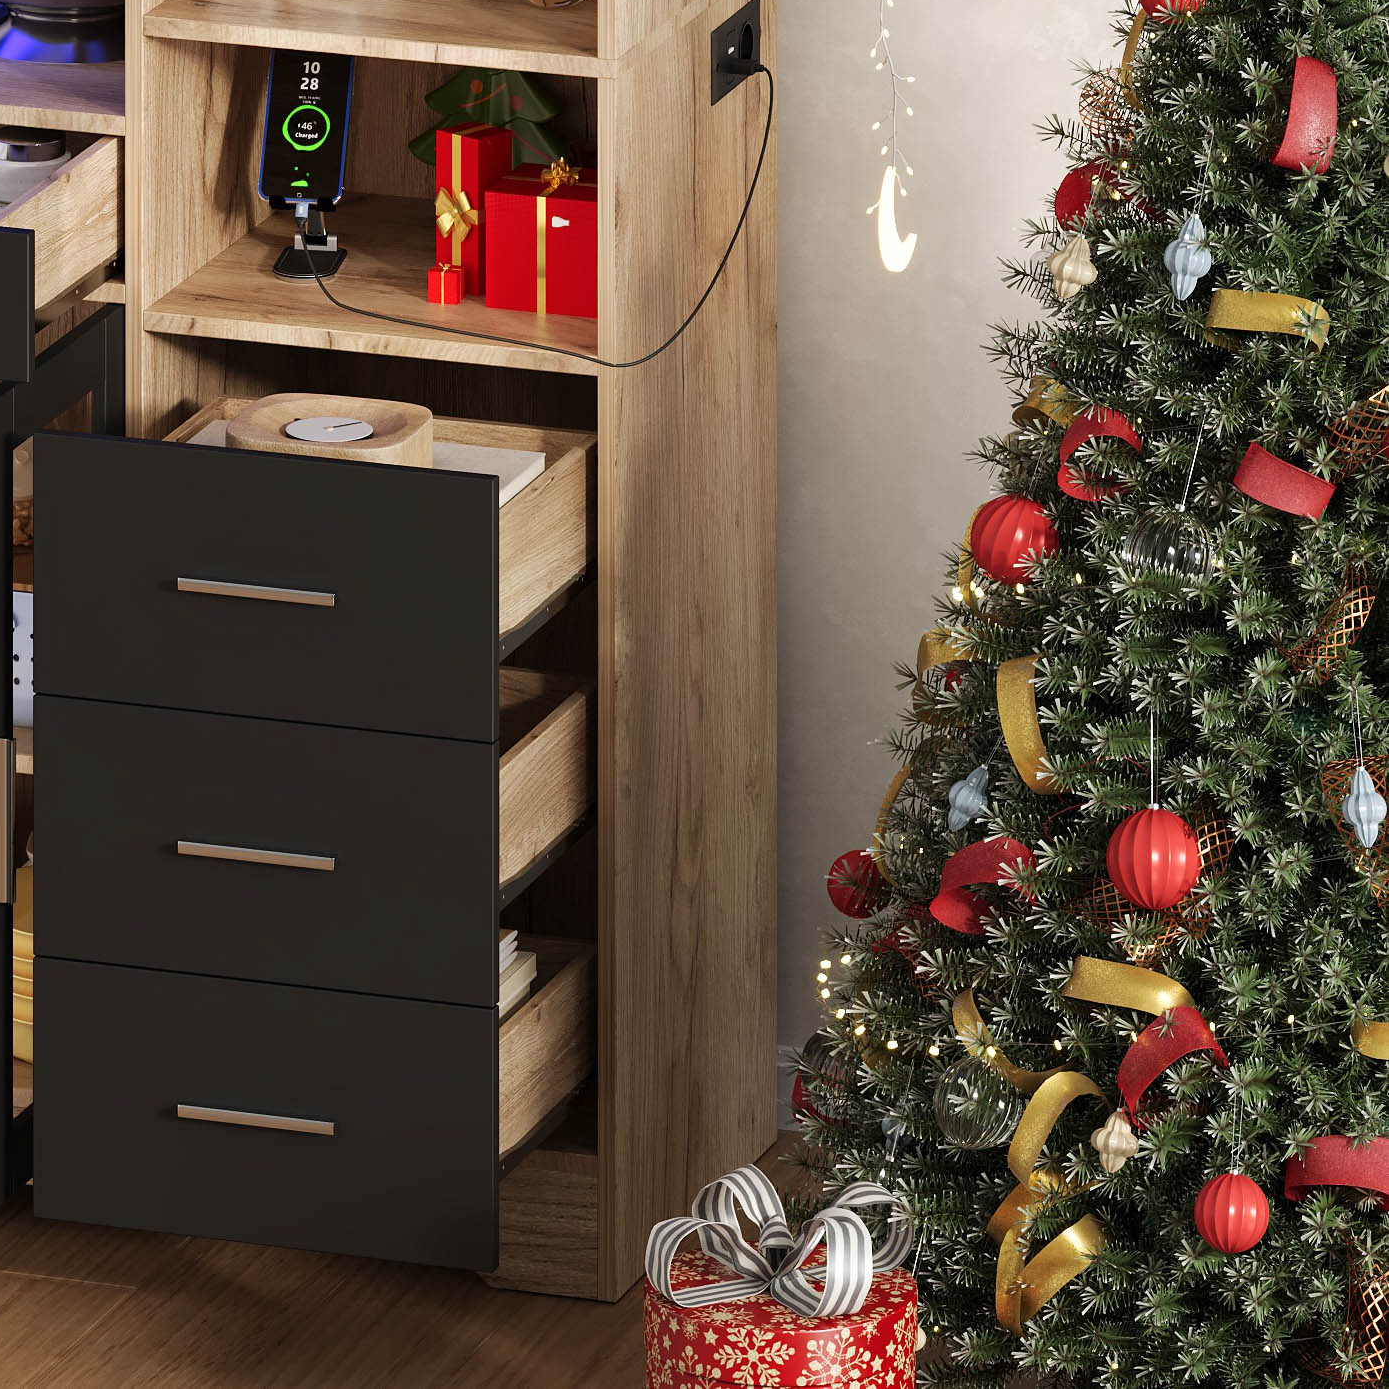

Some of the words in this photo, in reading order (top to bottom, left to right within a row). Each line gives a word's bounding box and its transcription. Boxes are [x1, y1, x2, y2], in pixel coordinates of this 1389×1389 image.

[303, 61, 321, 74] 10
[300, 77, 319, 90] 28
[294, 132, 319, 140] Charged
